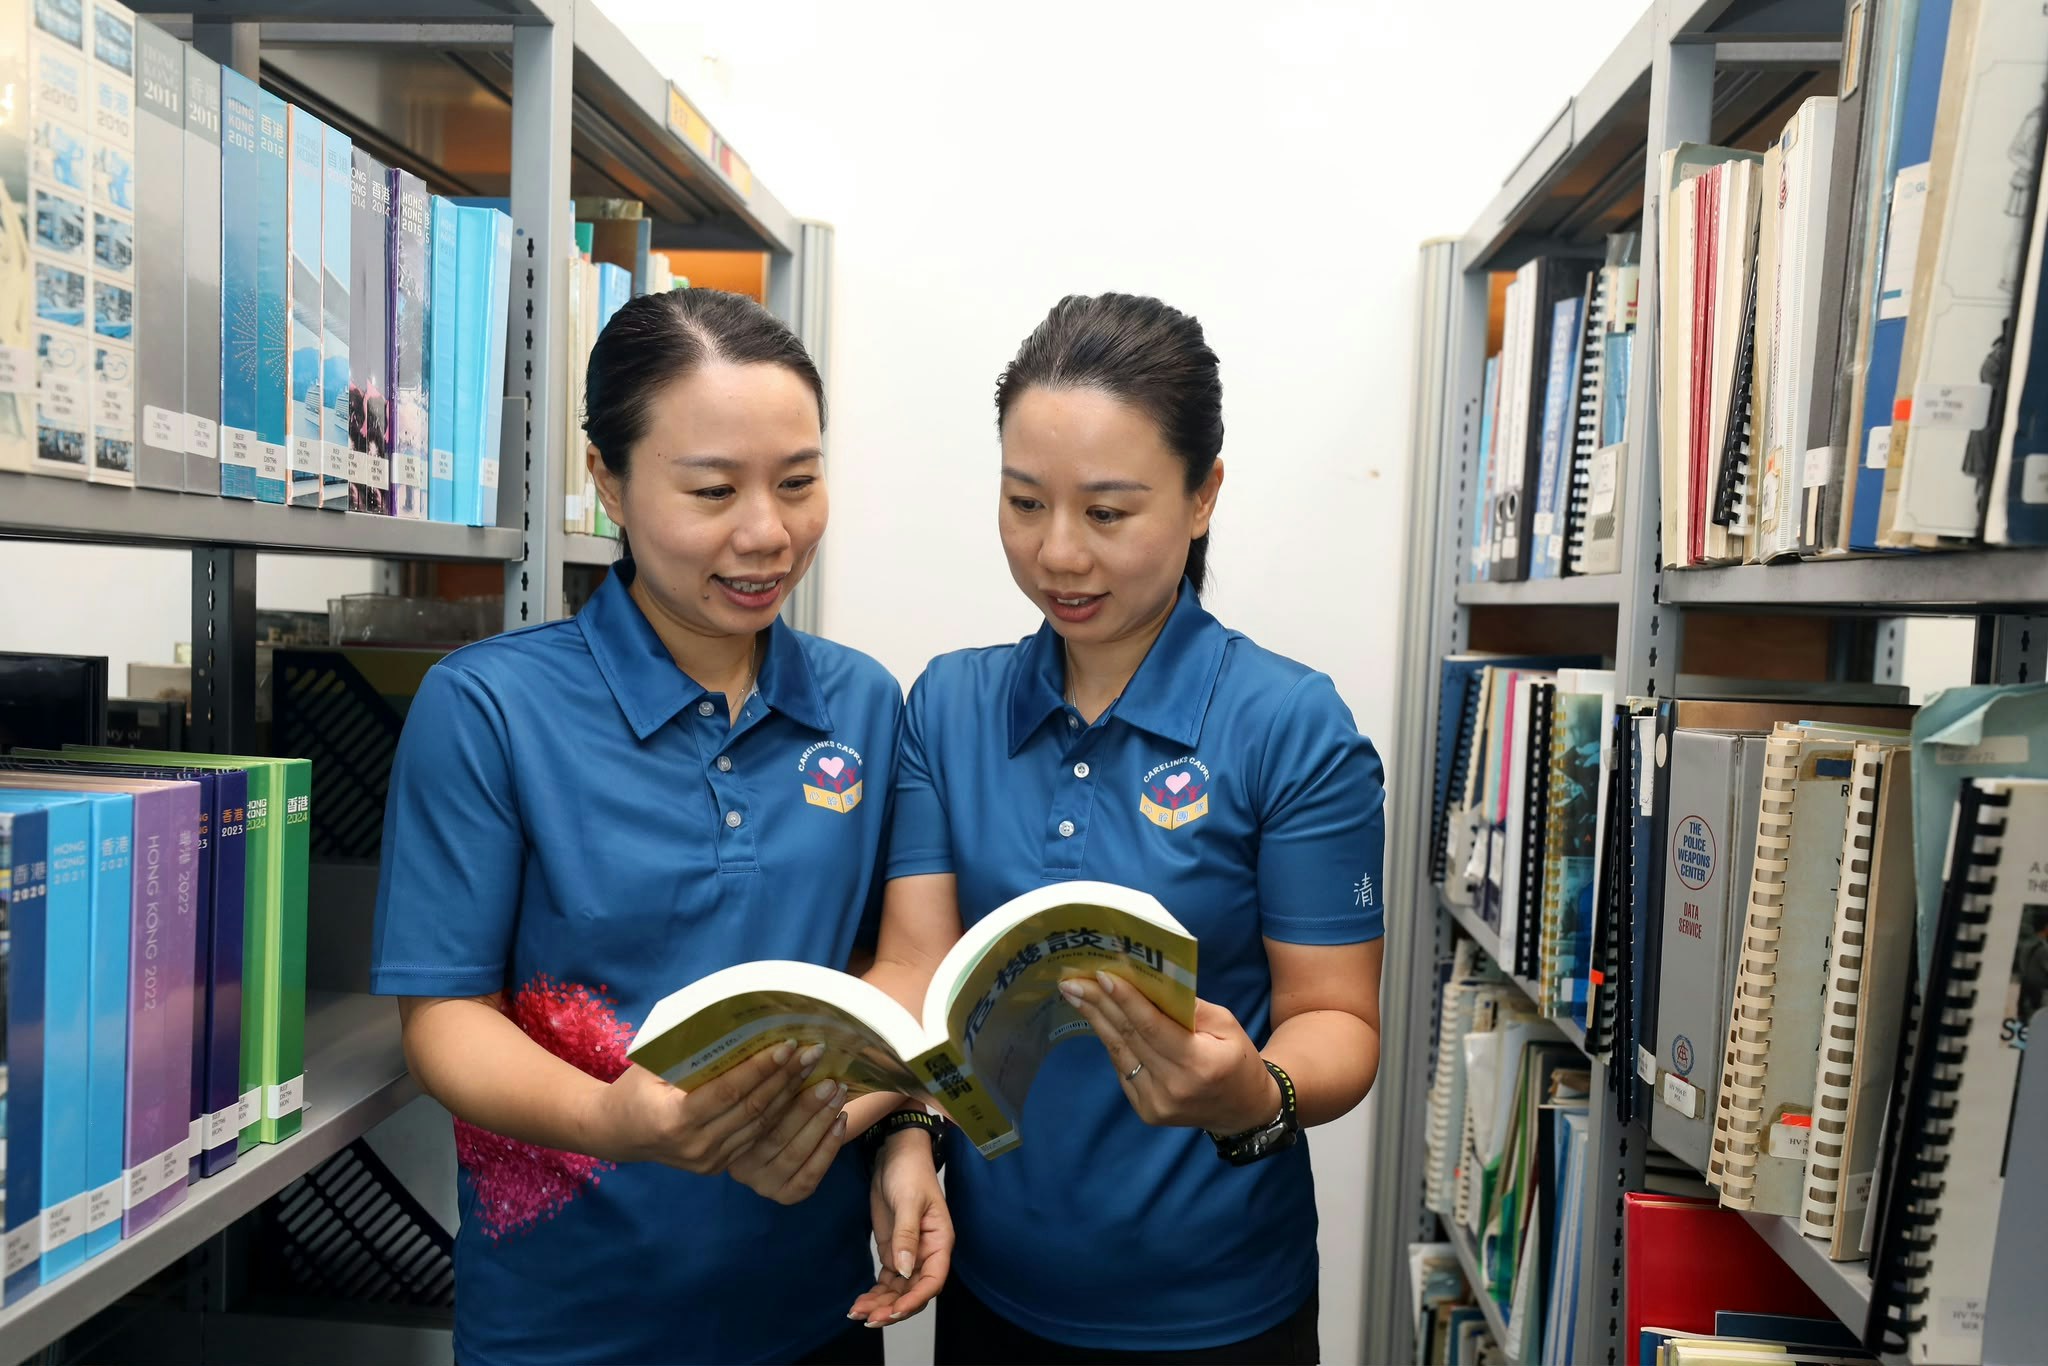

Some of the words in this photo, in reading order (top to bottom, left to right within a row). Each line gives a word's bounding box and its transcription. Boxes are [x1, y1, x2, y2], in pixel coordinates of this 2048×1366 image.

[143, 79, 178, 113] 2011
[189, 101, 218, 133] 2011
[228, 98, 255, 121] HONG
[228, 114, 255, 137] KONG
[261, 115, 284, 142] 香港
[228, 129, 255, 153] 2012
[261, 137, 284, 159] 2012
[372, 180, 391, 204] 香港
[402, 191, 422, 210] HONG
[352, 196, 366, 209] 014
[372, 199, 390, 217] 2014
[402, 204, 422, 225] KONG
[402, 219, 422, 237] 2015
[798, 741, 835, 772] CARELINKS
[837, 743, 863, 766] CADRE
[1144, 756, 1188, 783] CARELINKS
[1189, 757, 1210, 782] CADRE
[246, 807, 267, 819] KONG
[287, 795, 308, 813] 香港
[222, 808, 244, 824] 香港
[246, 817, 266, 831] 2024
[287, 811, 308, 825] 2024
[221, 824, 243, 837] 2023
[1689, 822, 1702, 836] THE
[54, 841, 86, 856] HONG
[102, 836, 128, 856] 香港
[198, 839, 208, 849] 23
[1683, 835, 1706, 852] POLICE
[54, 855, 86, 870] KONG
[101, 857, 129, 872] 2021
[147, 835, 160, 897] HONG
[1678, 848, 1711, 868] WEAPONS
[14, 862, 46, 885] 香港
[54, 869, 87, 885] 2021
[1680, 864, 1706, 882] CENTER
[13, 884, 46, 902] 2020
[178, 871, 190, 915] 2022
[1353, 872, 1373, 907] 清
[1684, 902, 1699, 920] DATA
[145, 902, 159, 960] KONG
[1678, 918, 1703, 939] SERVICE
[144, 966, 157, 1012] 2022
[965, 927, 1163, 1051] 危機談判
